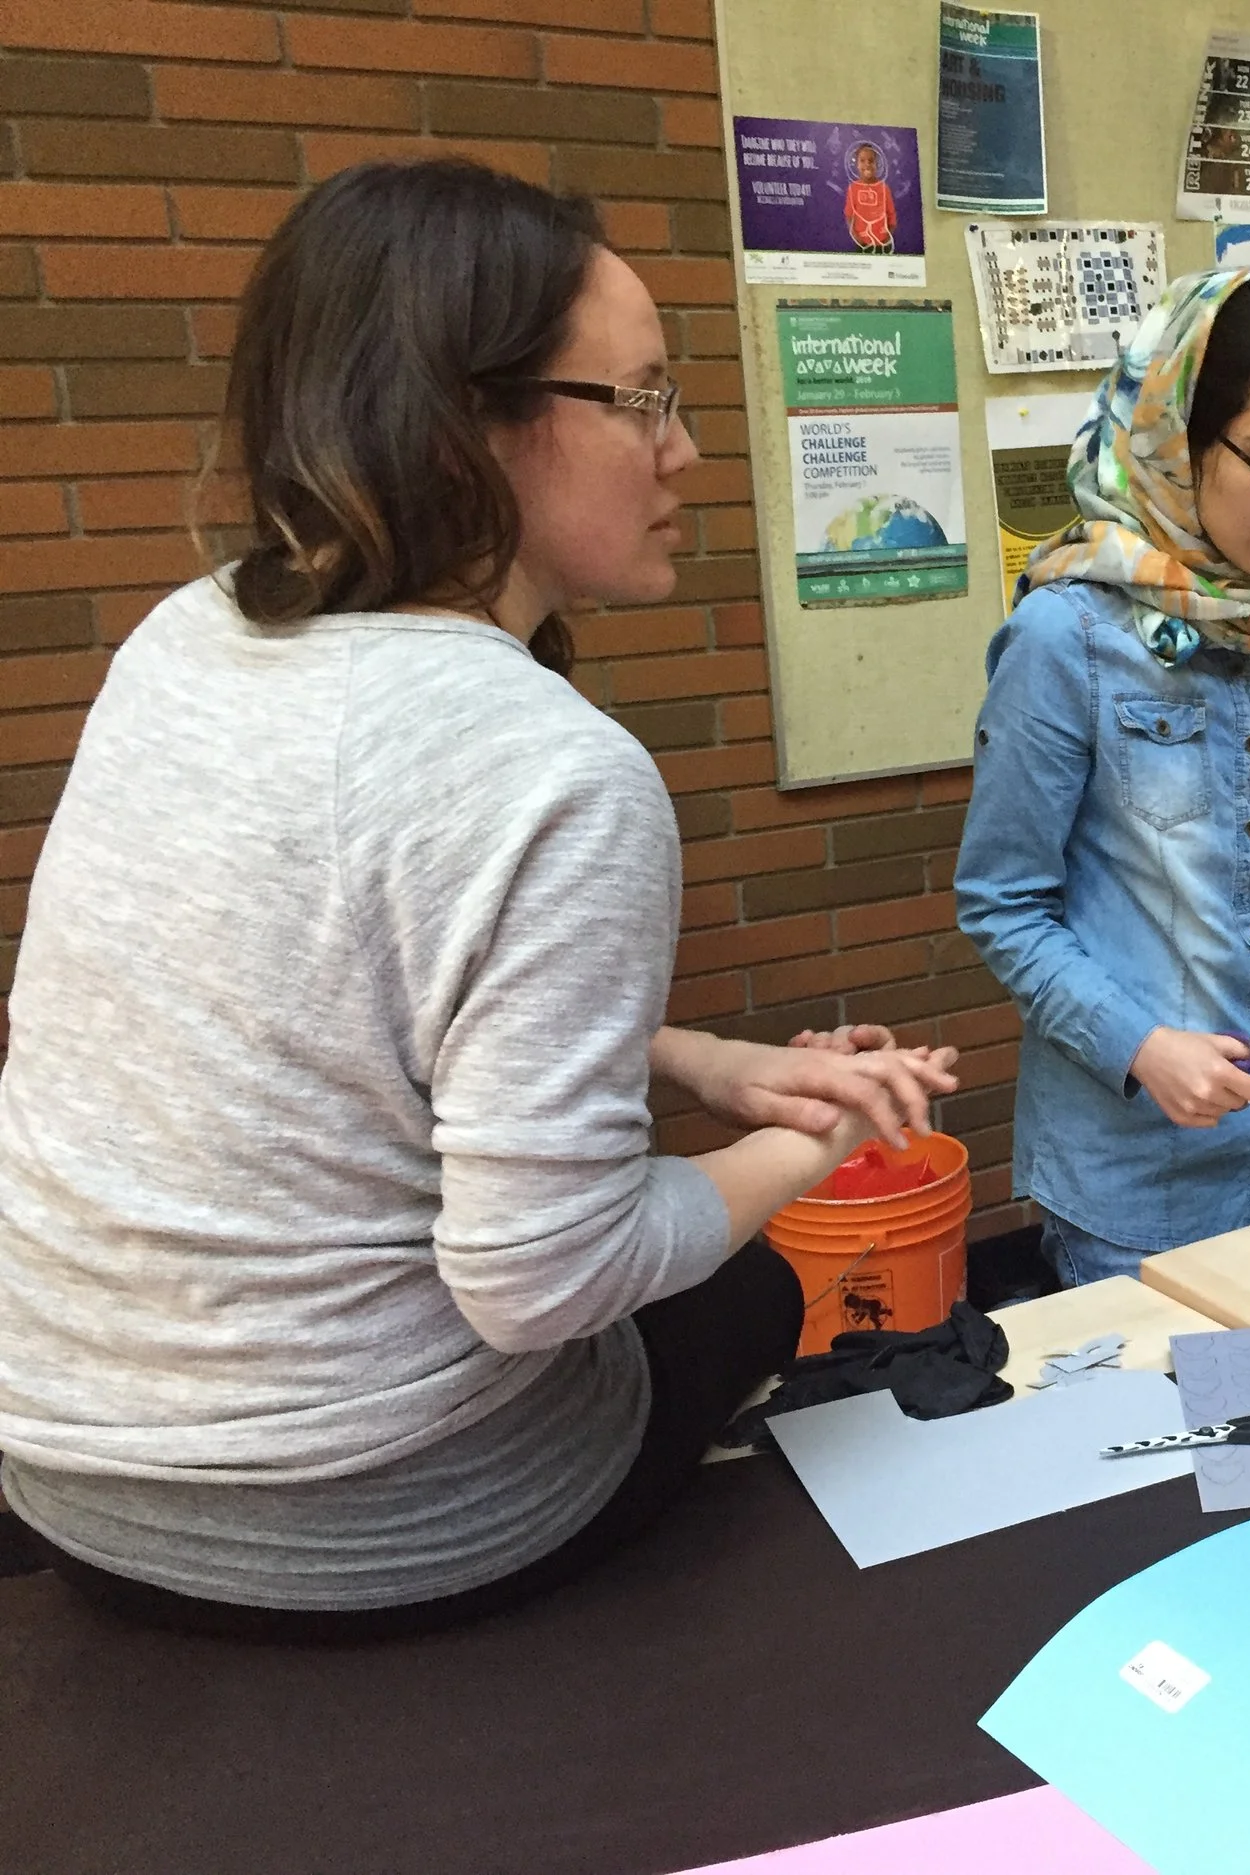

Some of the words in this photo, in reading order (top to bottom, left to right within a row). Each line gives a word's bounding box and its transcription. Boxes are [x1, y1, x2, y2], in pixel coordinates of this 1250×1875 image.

[1235, 75, 1249, 89] 22
[792, 331, 901, 355] international
[843, 356, 897, 377] week
[800, 422, 851, 436] WORLD'S
[801, 437, 867, 450] CHALLENGE
[803, 451, 867, 465] CHALLENGE
[803, 465, 878, 479] COMPETITION
